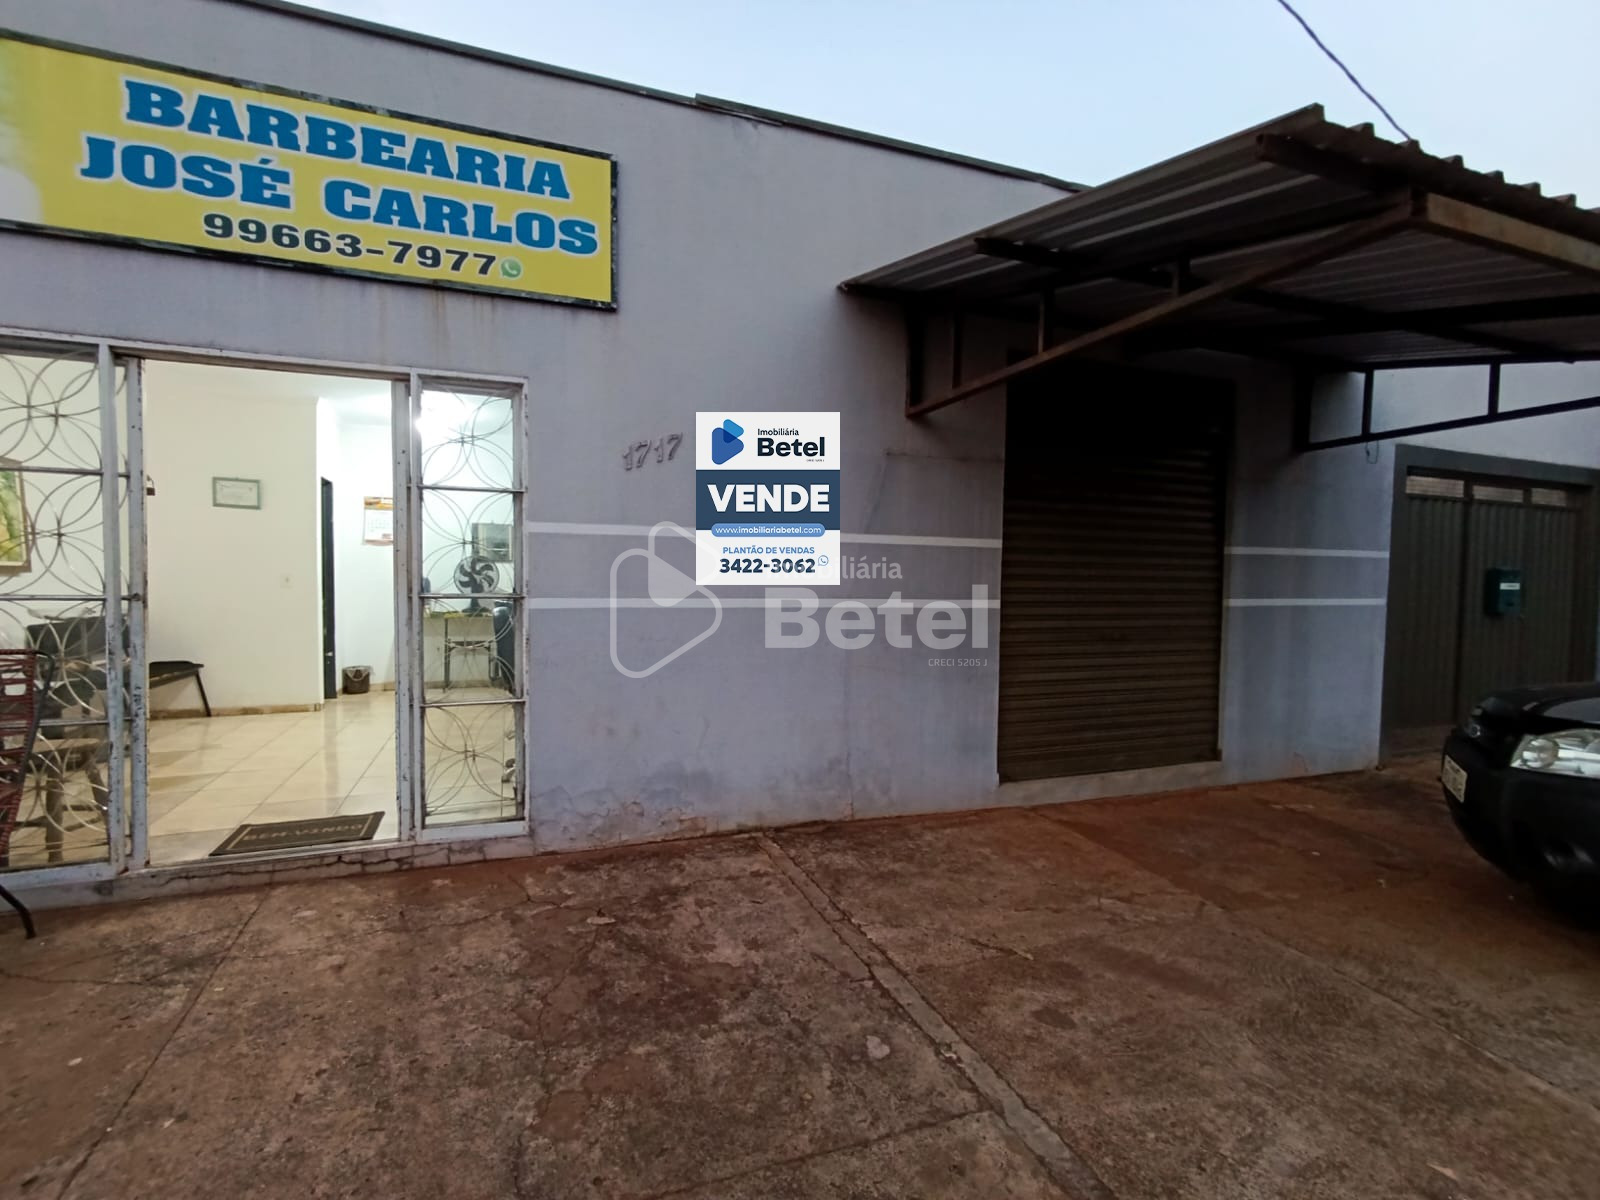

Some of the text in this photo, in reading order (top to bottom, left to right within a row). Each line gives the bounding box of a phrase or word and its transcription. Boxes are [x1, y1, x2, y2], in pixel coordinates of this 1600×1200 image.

[124, 79, 570, 199] BARBEARIA
[80, 136, 598, 255] JOSÉ CARLOS
[203, 213, 497, 276] 99663-7977
[623, 432, 683, 471] 1717
